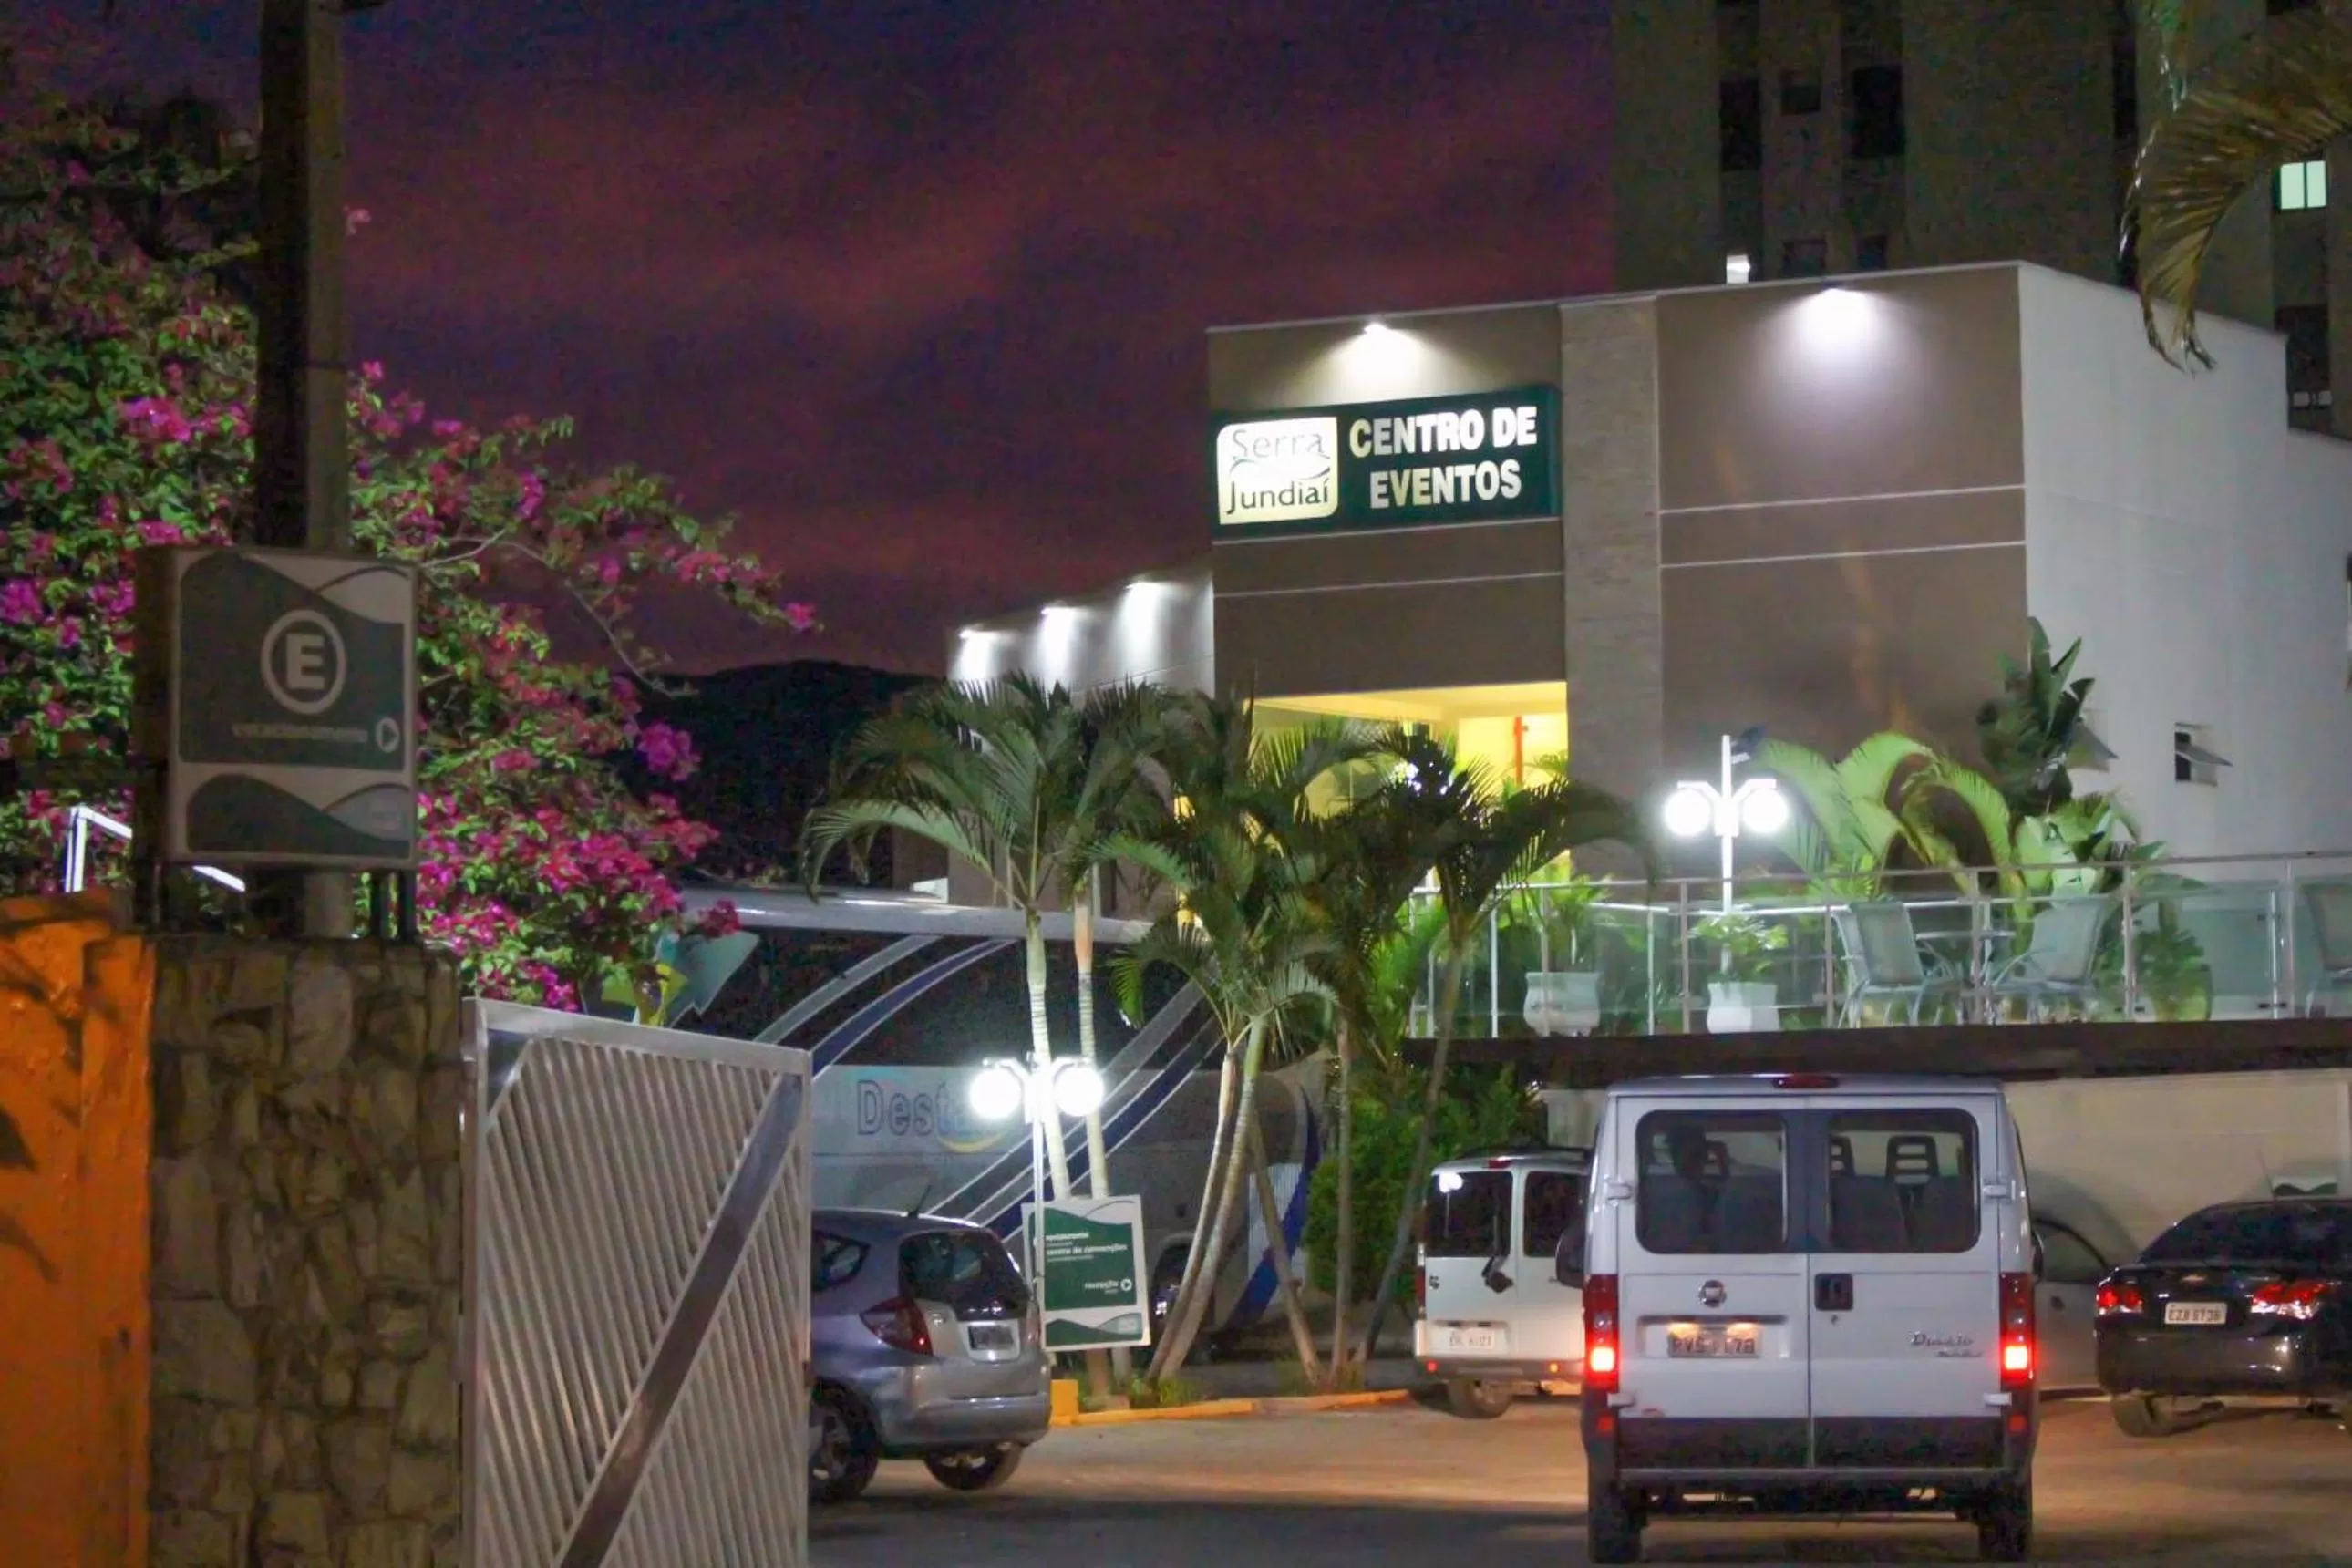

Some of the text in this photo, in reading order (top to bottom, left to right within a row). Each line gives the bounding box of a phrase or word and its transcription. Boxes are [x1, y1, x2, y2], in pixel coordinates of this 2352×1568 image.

[1232, 428, 1327, 459] Serra
[1348, 406, 1538, 458] CENTRO DE
[1226, 477, 1329, 514] Jundiaí
[1369, 459, 1522, 509] EVENTOS
[285, 634, 325, 690] E
